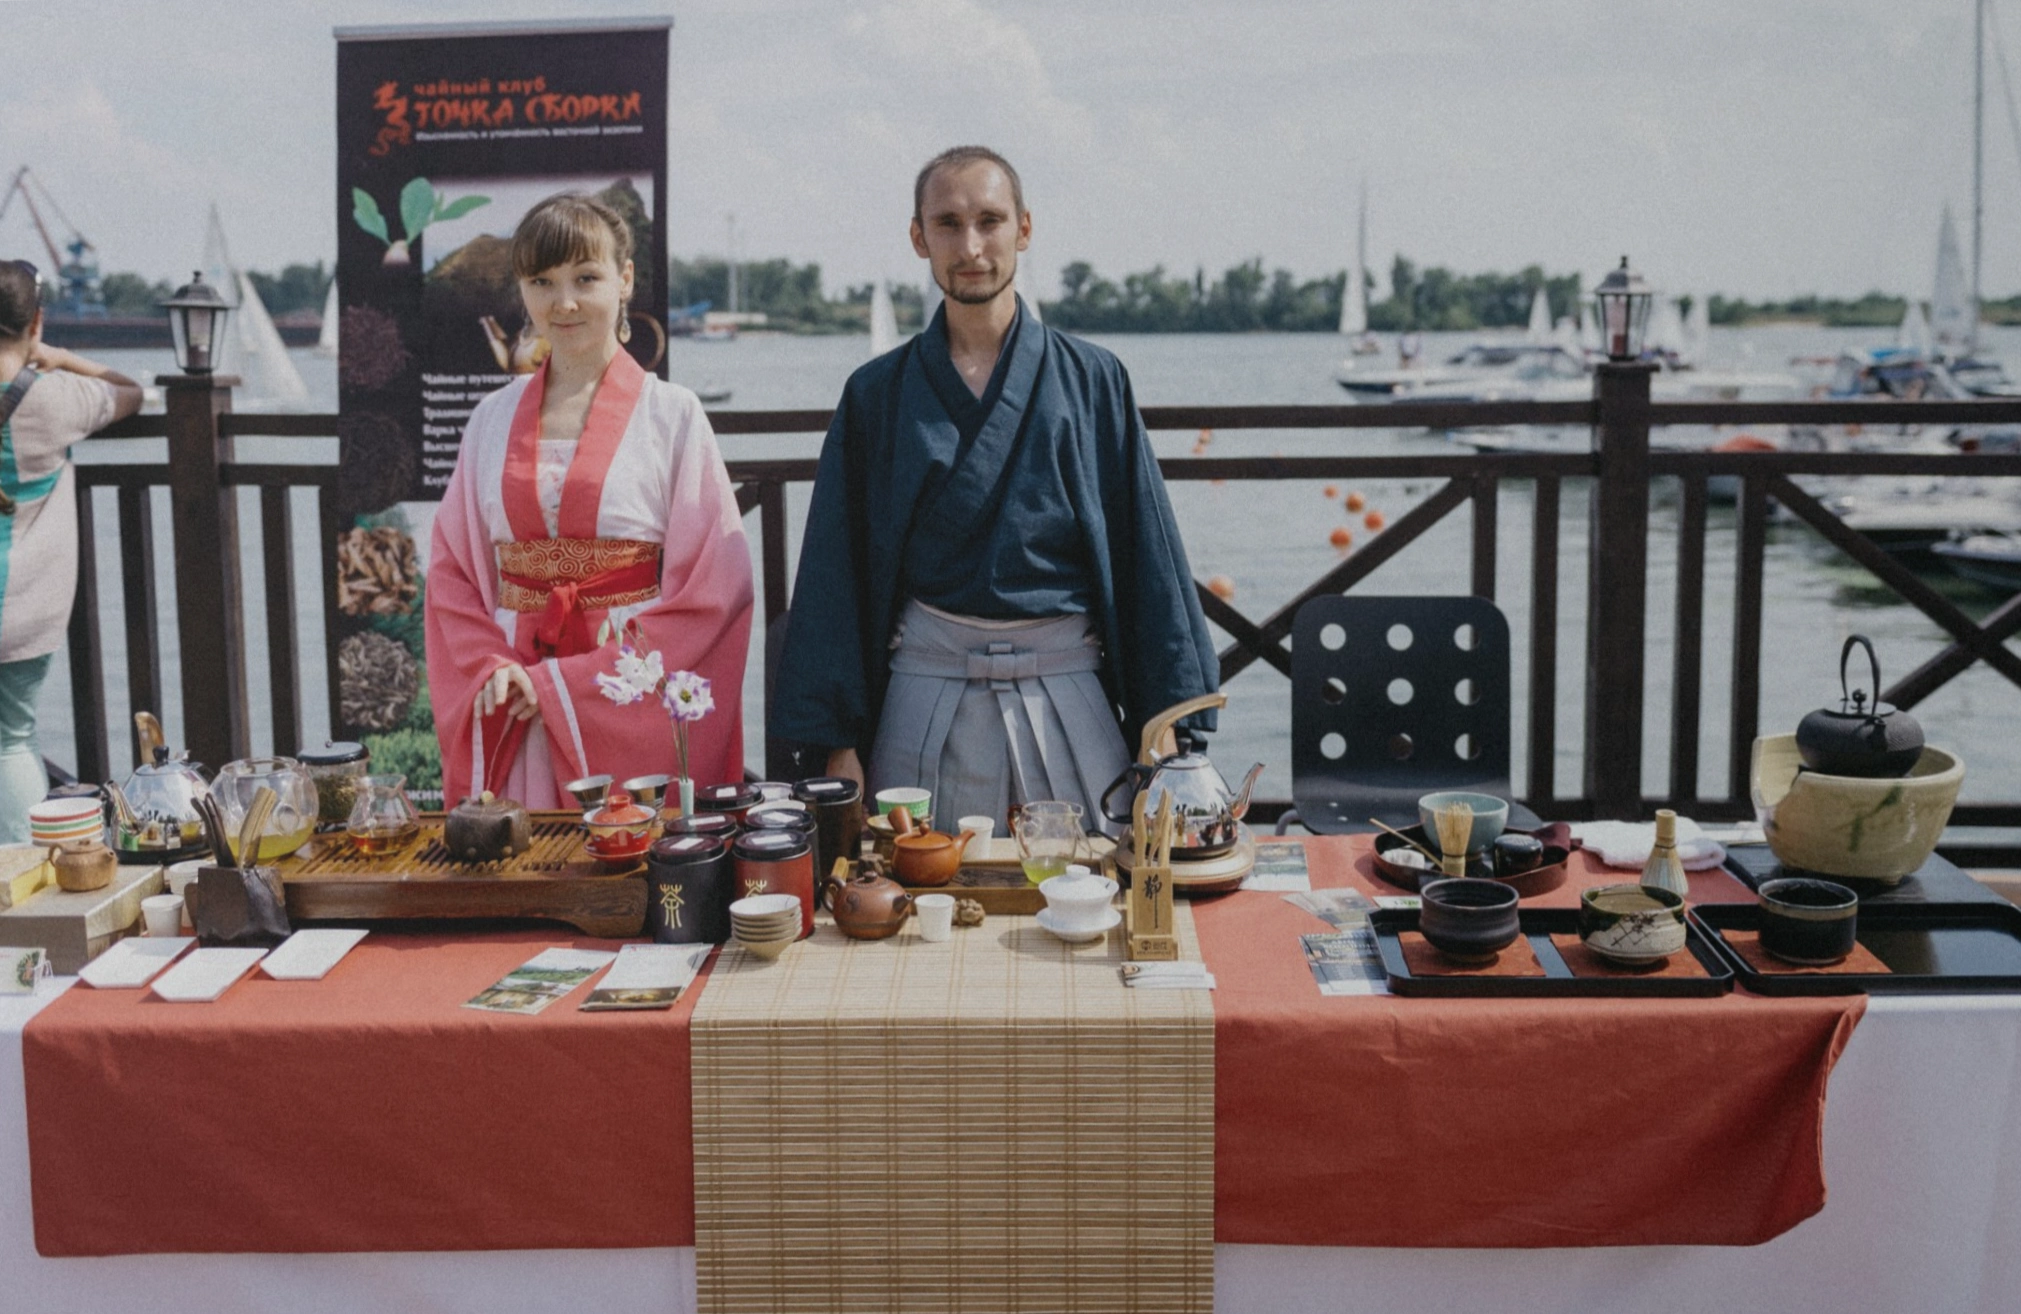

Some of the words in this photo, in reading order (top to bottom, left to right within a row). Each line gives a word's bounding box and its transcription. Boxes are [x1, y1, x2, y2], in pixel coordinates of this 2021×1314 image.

[413, 78, 490, 96] чайный
[497, 75, 546, 96] клуб
[413, 97, 514, 128] ТОЧКА
[524, 90, 642, 124] СБОРКИ
